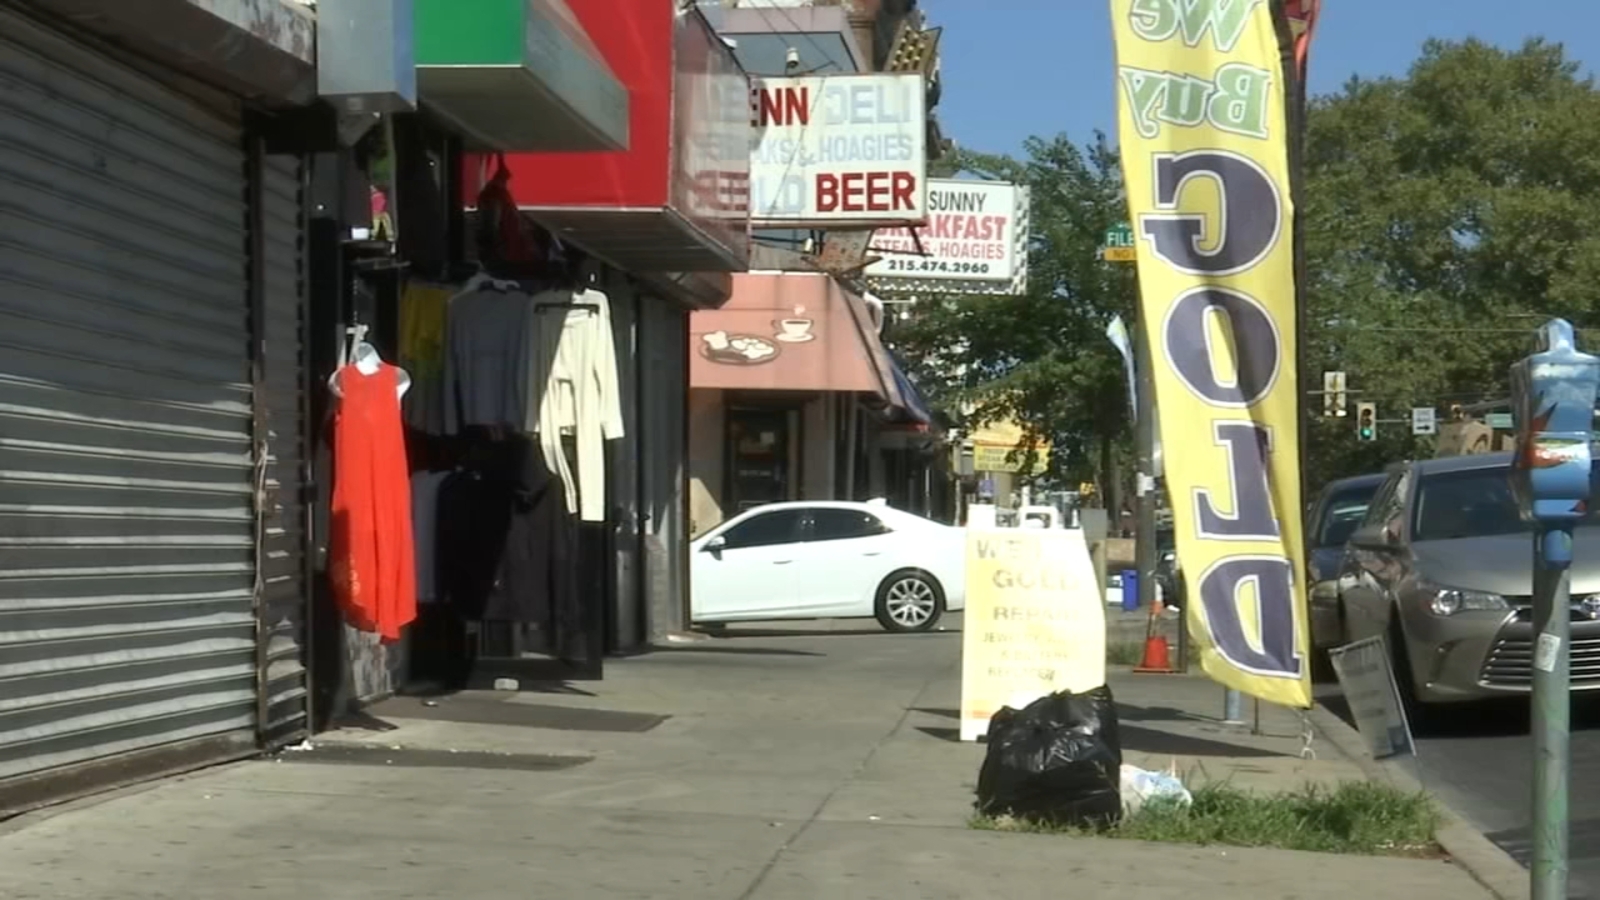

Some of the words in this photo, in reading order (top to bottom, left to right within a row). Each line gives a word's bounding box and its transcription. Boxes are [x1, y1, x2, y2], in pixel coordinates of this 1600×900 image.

[825, 84, 911, 124] DELI
[819, 134, 914, 163] HOAGIES
[816, 170, 916, 213] BEER
[928, 190, 987, 212] SUNNY
[939, 241, 1005, 260] HOAGIES
[888, 259, 990, 274] 215.474.2960
